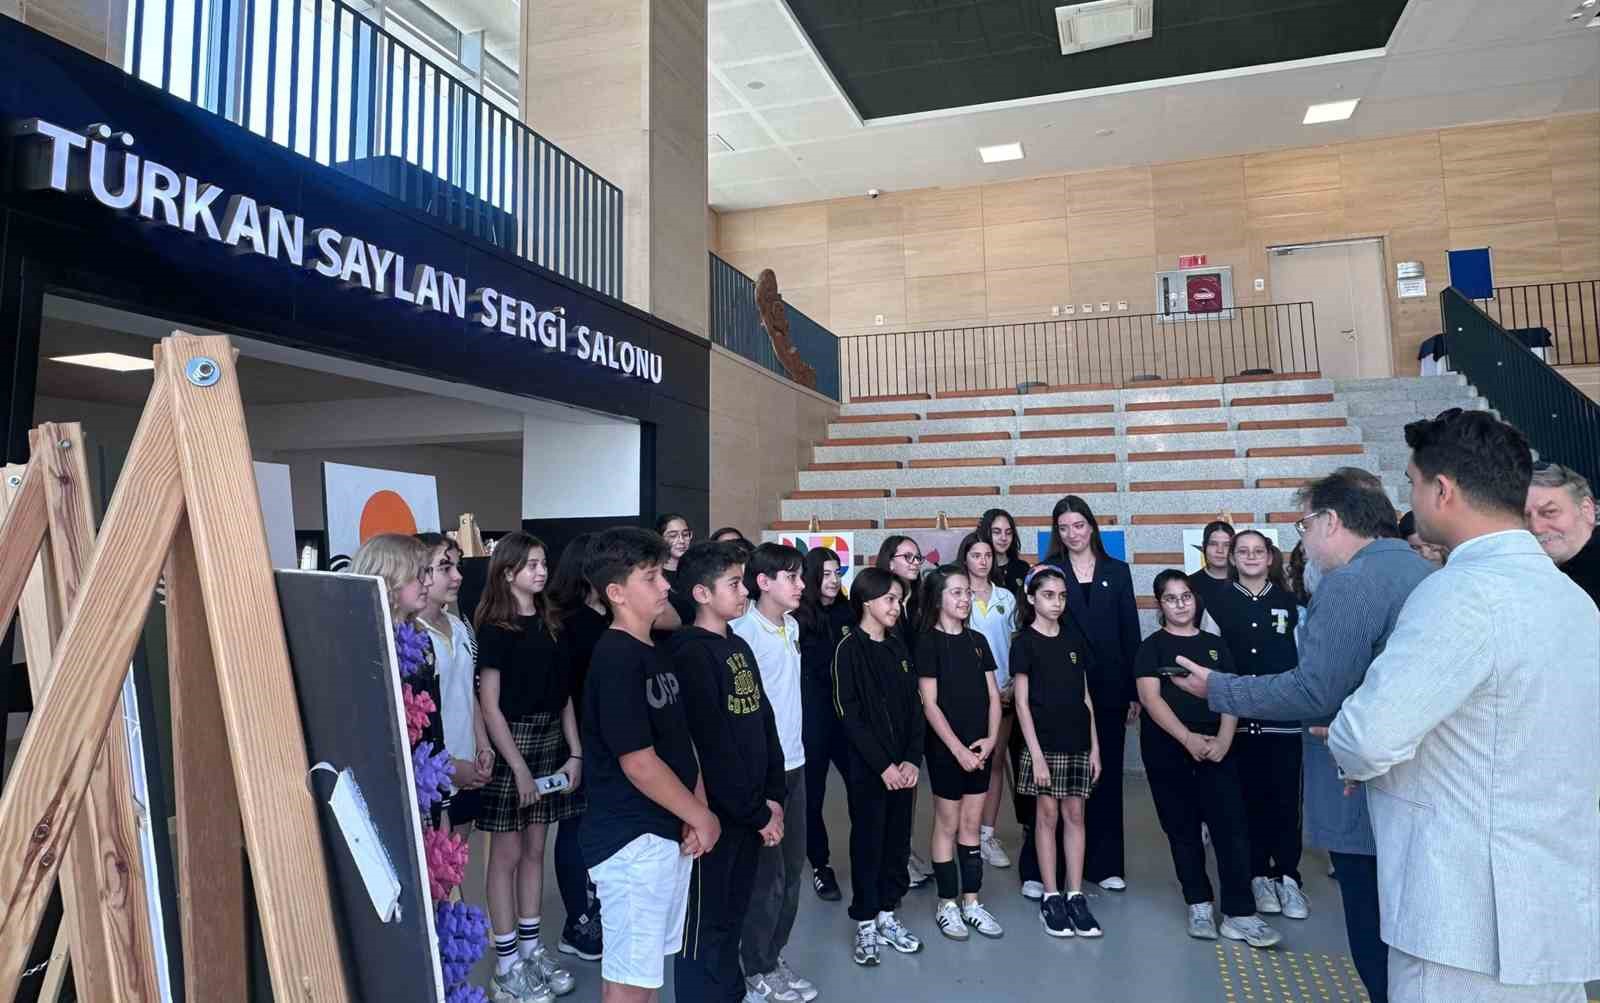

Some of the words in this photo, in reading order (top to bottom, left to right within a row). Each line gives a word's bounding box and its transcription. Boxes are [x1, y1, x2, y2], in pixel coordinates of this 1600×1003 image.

[35, 119, 304, 266] TÜRKAN
[315, 228, 466, 318] SAYLAN
[576, 325, 663, 384] SALONU
